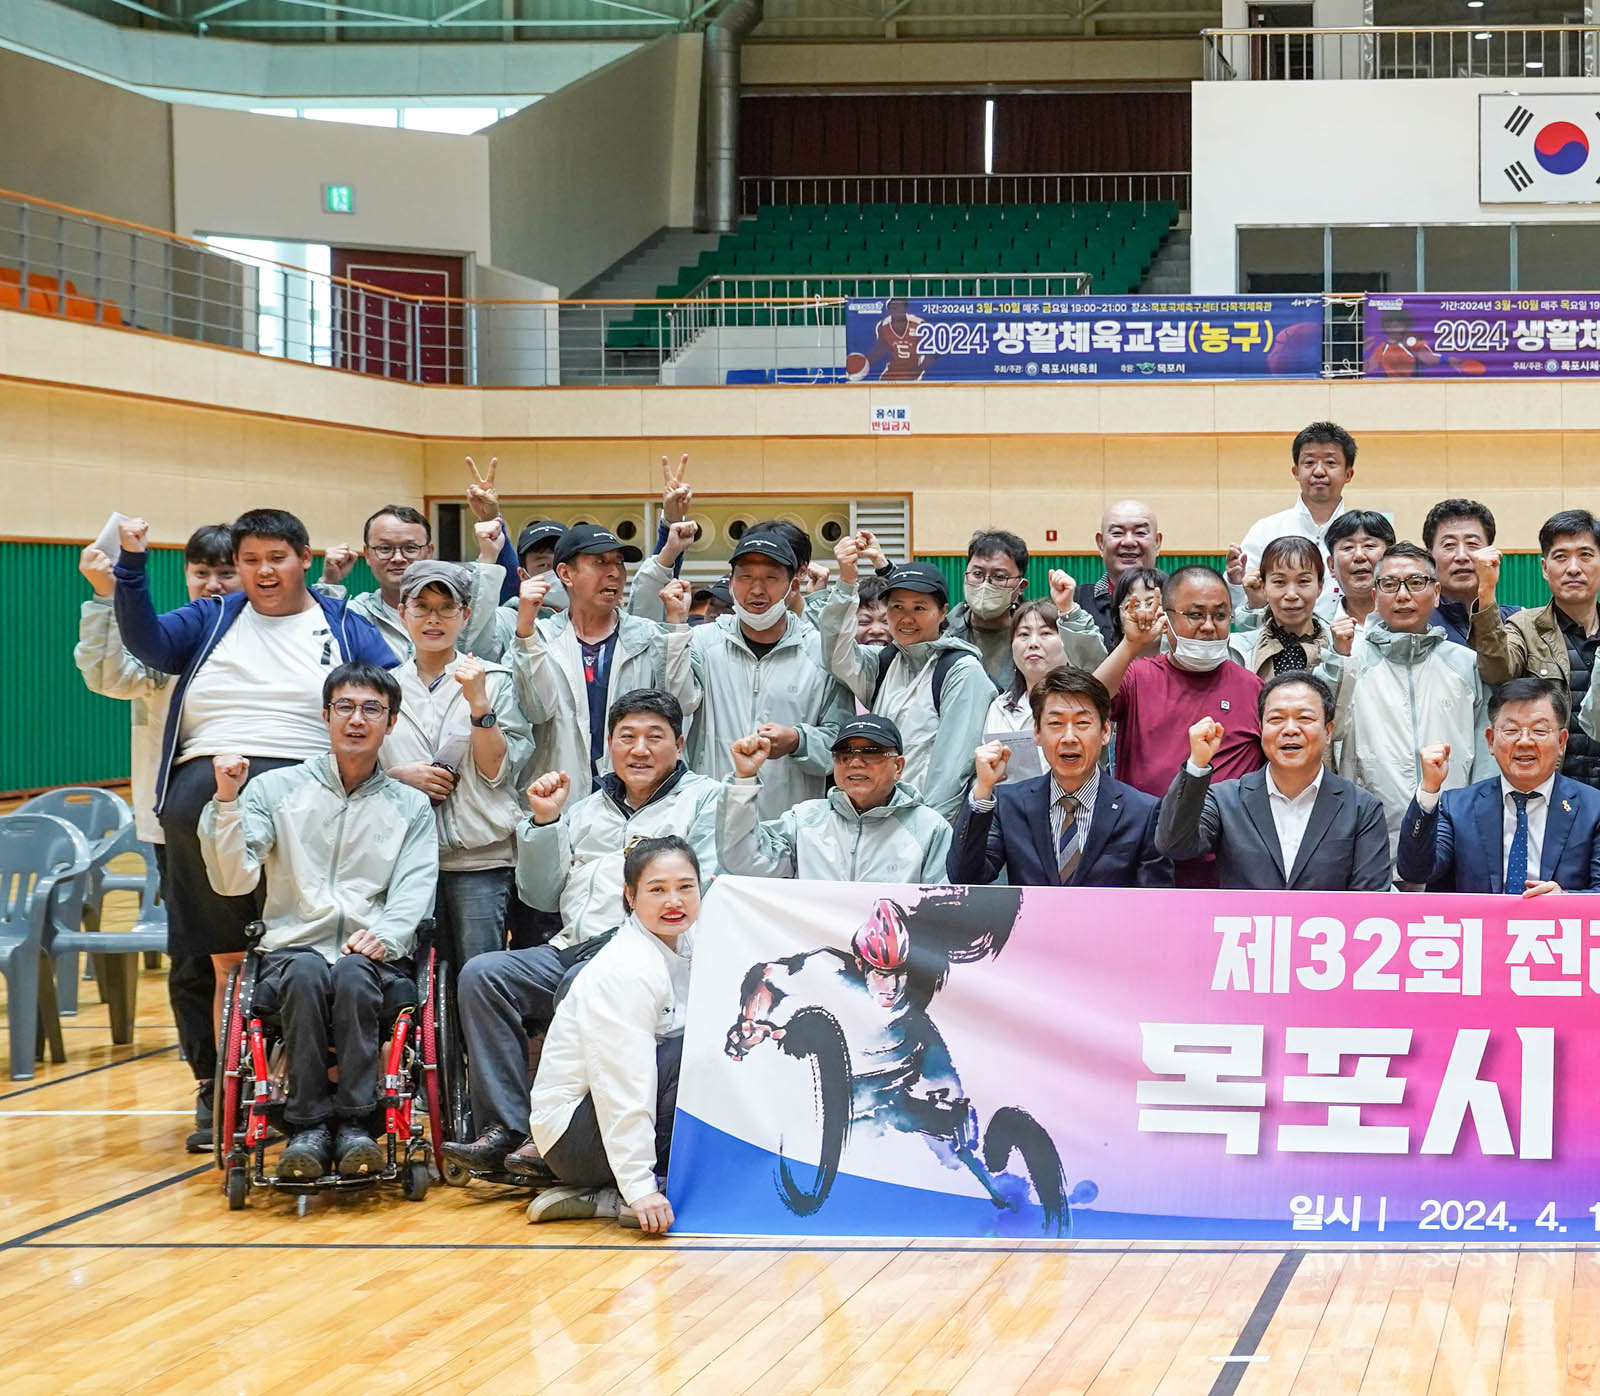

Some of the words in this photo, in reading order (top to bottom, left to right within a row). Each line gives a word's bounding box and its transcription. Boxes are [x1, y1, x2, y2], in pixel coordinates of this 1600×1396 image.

[976, 302, 1020, 314] 3월~10월
[1023, 303, 1039, 313] 매주
[1042, 302, 1069, 314] 금요일
[1071, 303, 1127, 313] 19:00~21:00
[1494, 300, 1539, 312] 3월~10월
[1541, 300, 1558, 311] 매주
[1560, 300, 1587, 311] 목요일
[916, 322, 989, 354] 2024
[993, 320, 1274, 354] 생활체육교실(농구)
[1434, 319, 1509, 351] 2024
[1041, 364, 1098, 375] 목포시체육회
[1157, 363, 1186, 374] 목포시
[871, 421, 910, 431] 반입금지
[1211, 916, 1482, 995] 제32회
[1136, 1024, 1555, 1160] 목포시
[1289, 1195, 1361, 1231] 일시
[1418, 1199, 1517, 1232] 2024.
[1535, 1201, 1567, 1232] 4.
